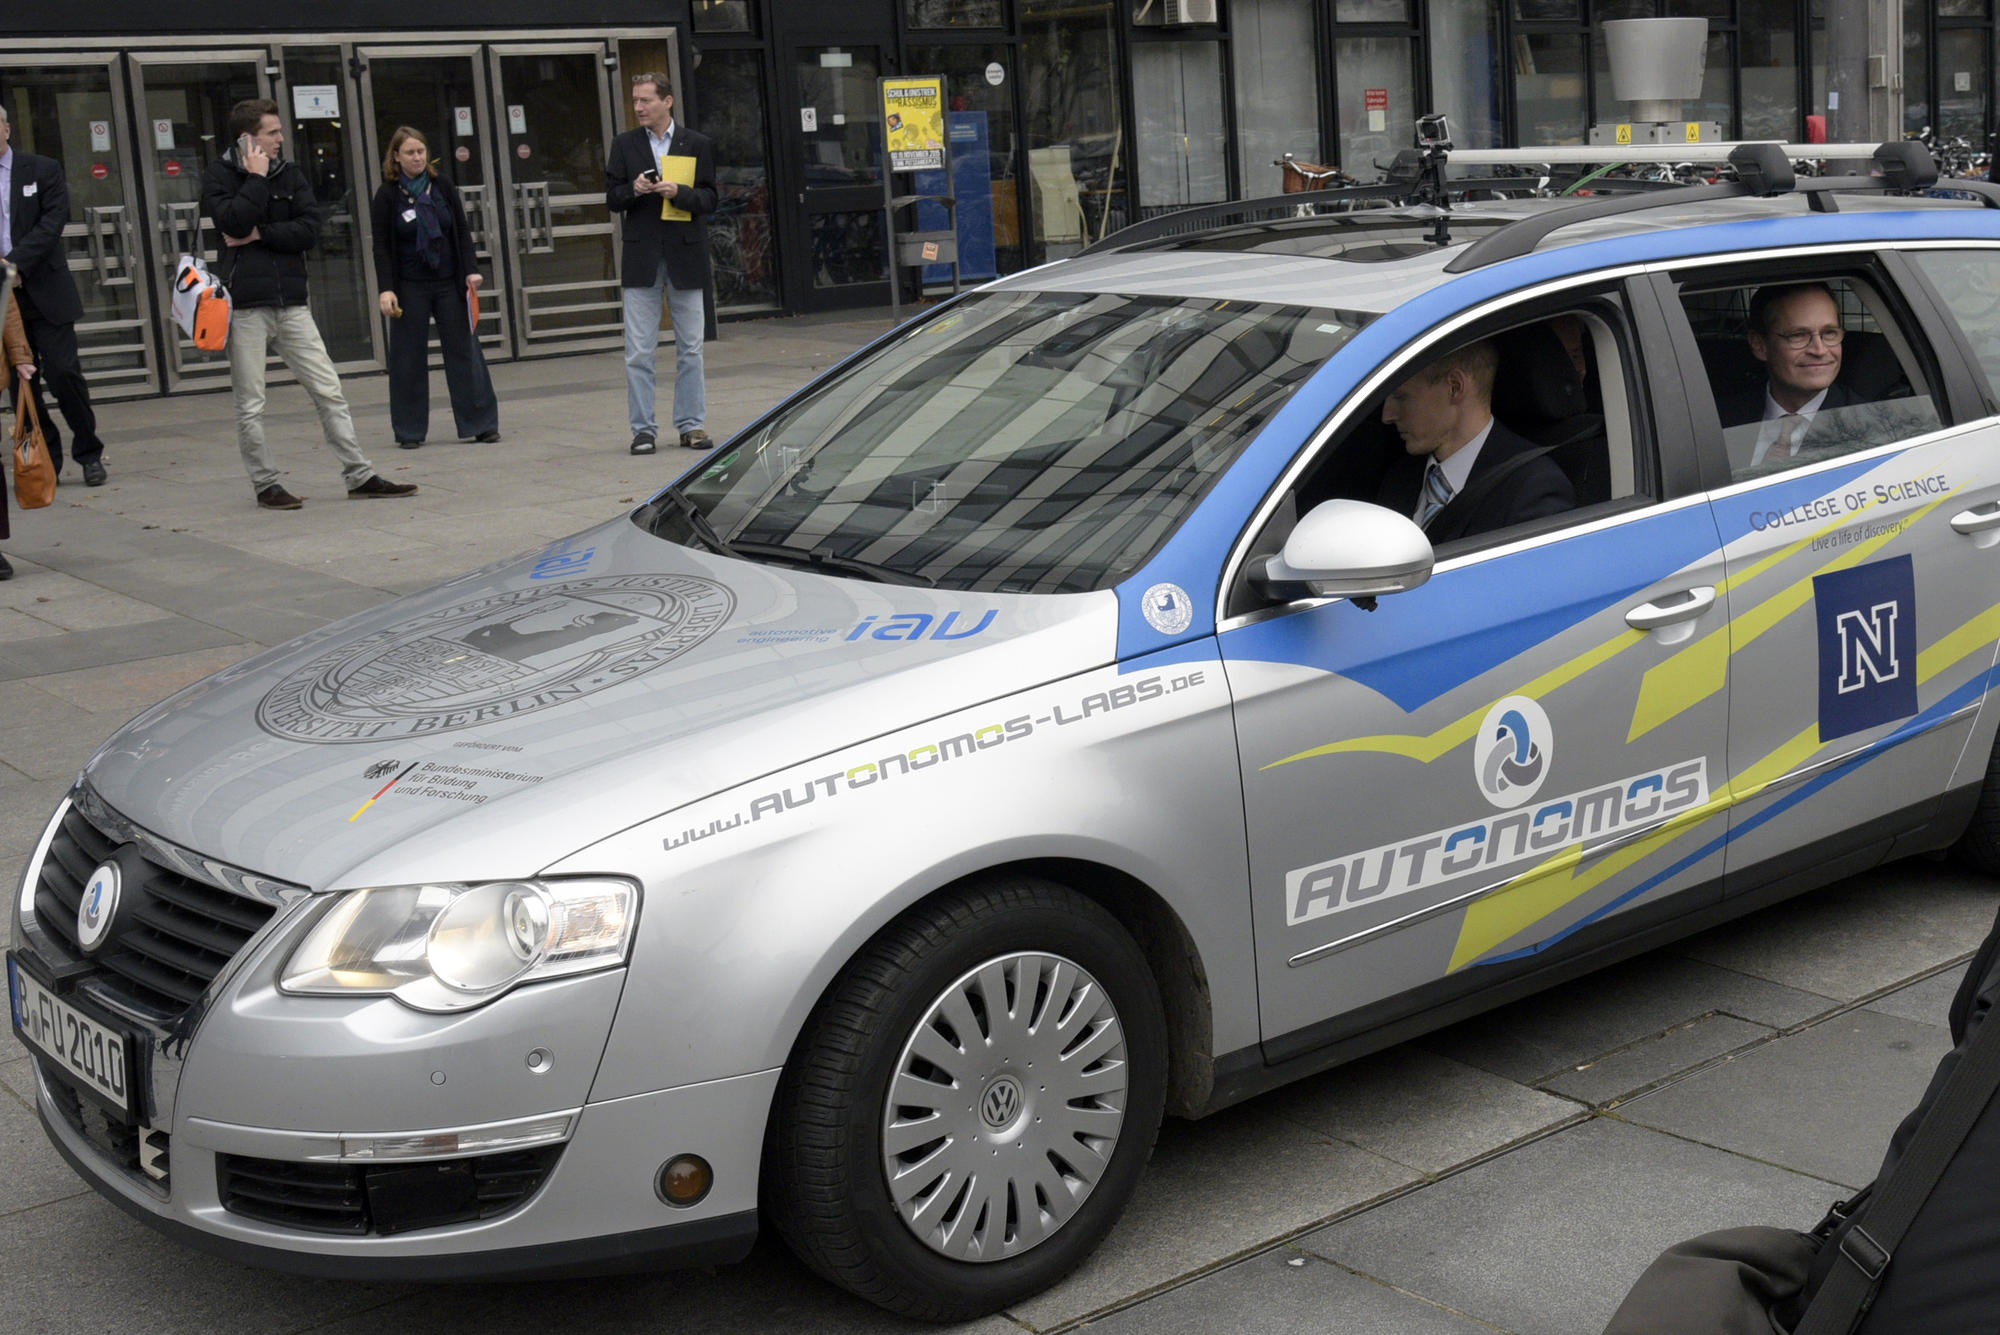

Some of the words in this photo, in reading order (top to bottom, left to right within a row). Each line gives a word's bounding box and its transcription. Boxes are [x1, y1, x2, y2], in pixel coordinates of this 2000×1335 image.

[1750, 498, 1841, 532] COLLEGE
[1844, 491, 1867, 511] OF
[1873, 475, 1950, 505] SCIENCE
[1812, 539, 1829, 552] Live
[1831, 537, 1837, 547] a
[1838, 530, 1852, 545] life
[1854, 527, 1862, 541] of
[737, 636, 830, 644] engineering
[1836, 600, 1899, 695] N
[408, 683, 584, 734] BERLIN
[408, 774, 427, 784] für
[427, 775, 478, 790] Bildung
[421, 762, 544, 783] Bundesministerium
[394, 786, 421, 796] und
[422, 787, 488, 804] Forschung
[1294, 762, 1702, 919] AUTONOMOS
[18, 972, 30, 1028] B
[39, 991, 66, 1059] FU
[67, 1012, 125, 1098] 2010
